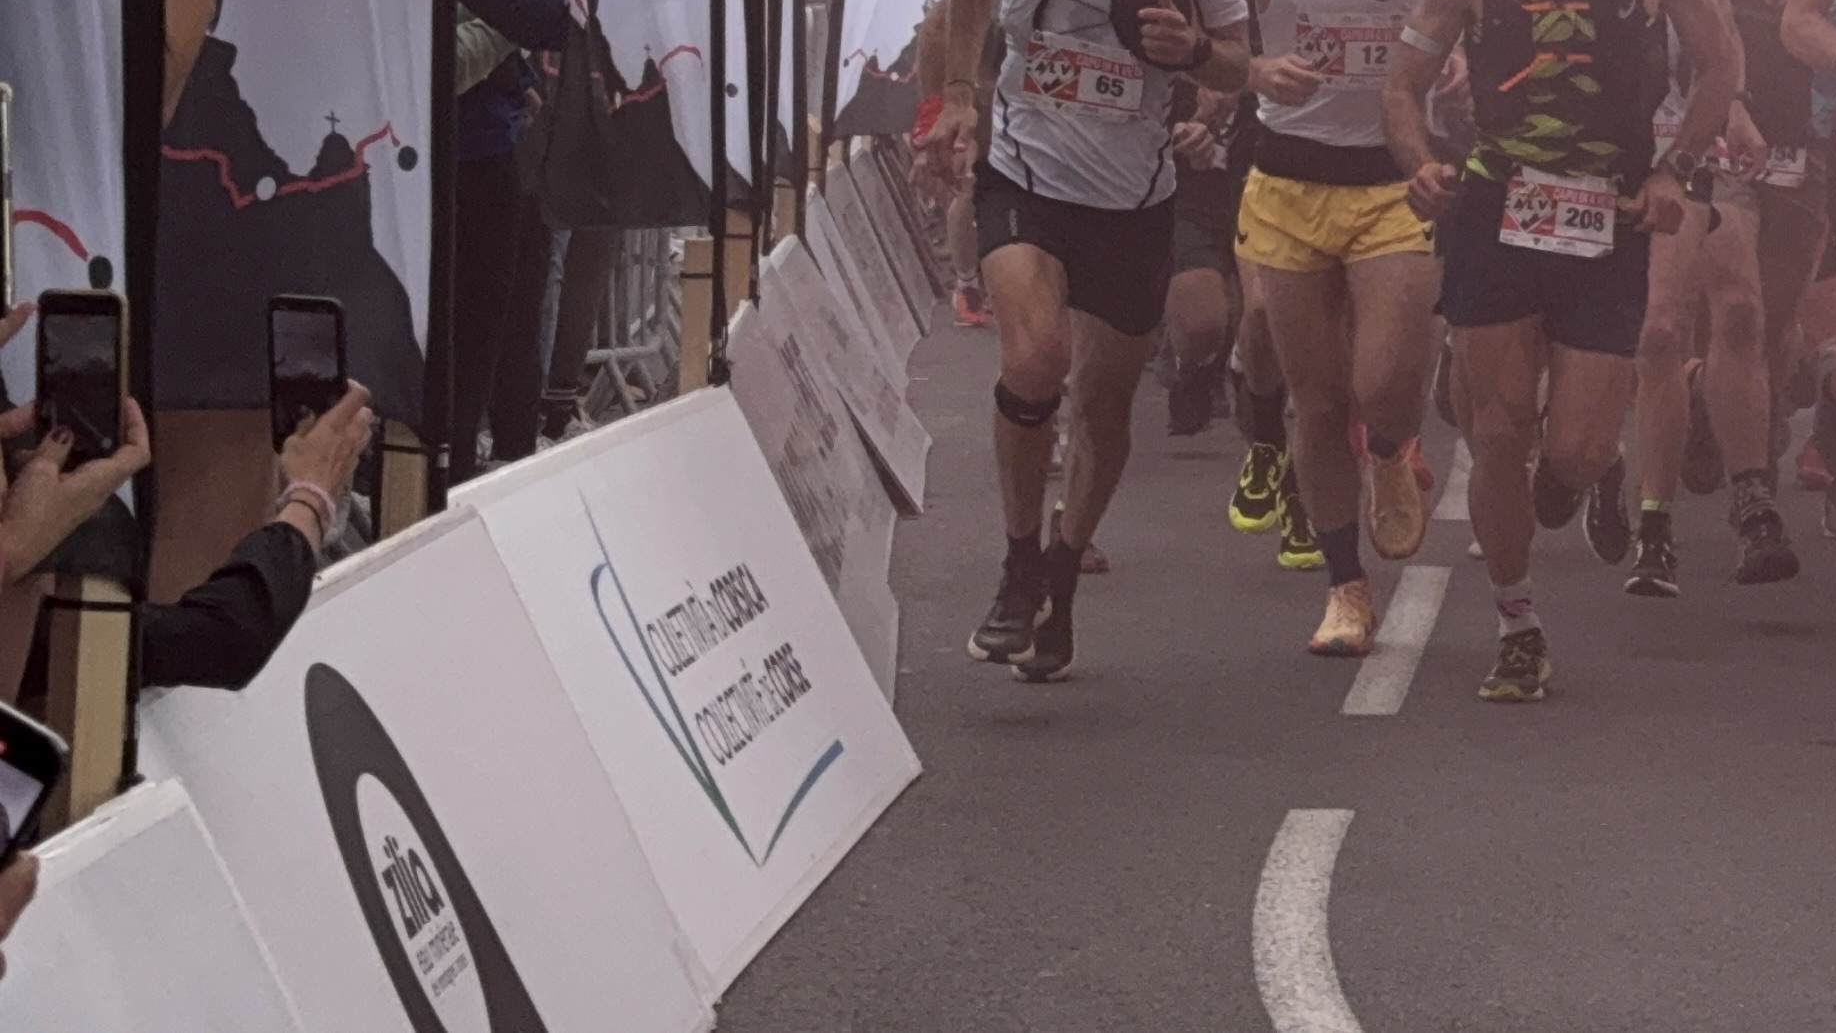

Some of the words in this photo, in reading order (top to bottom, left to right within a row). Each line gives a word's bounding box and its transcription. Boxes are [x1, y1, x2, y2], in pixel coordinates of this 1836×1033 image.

[1362, 45, 1388, 65] 12
[1095, 75, 1125, 98] 65
[1565, 207, 1605, 233] 208
[763, 642, 812, 708] CORSE
[381, 834, 446, 942] zilia
